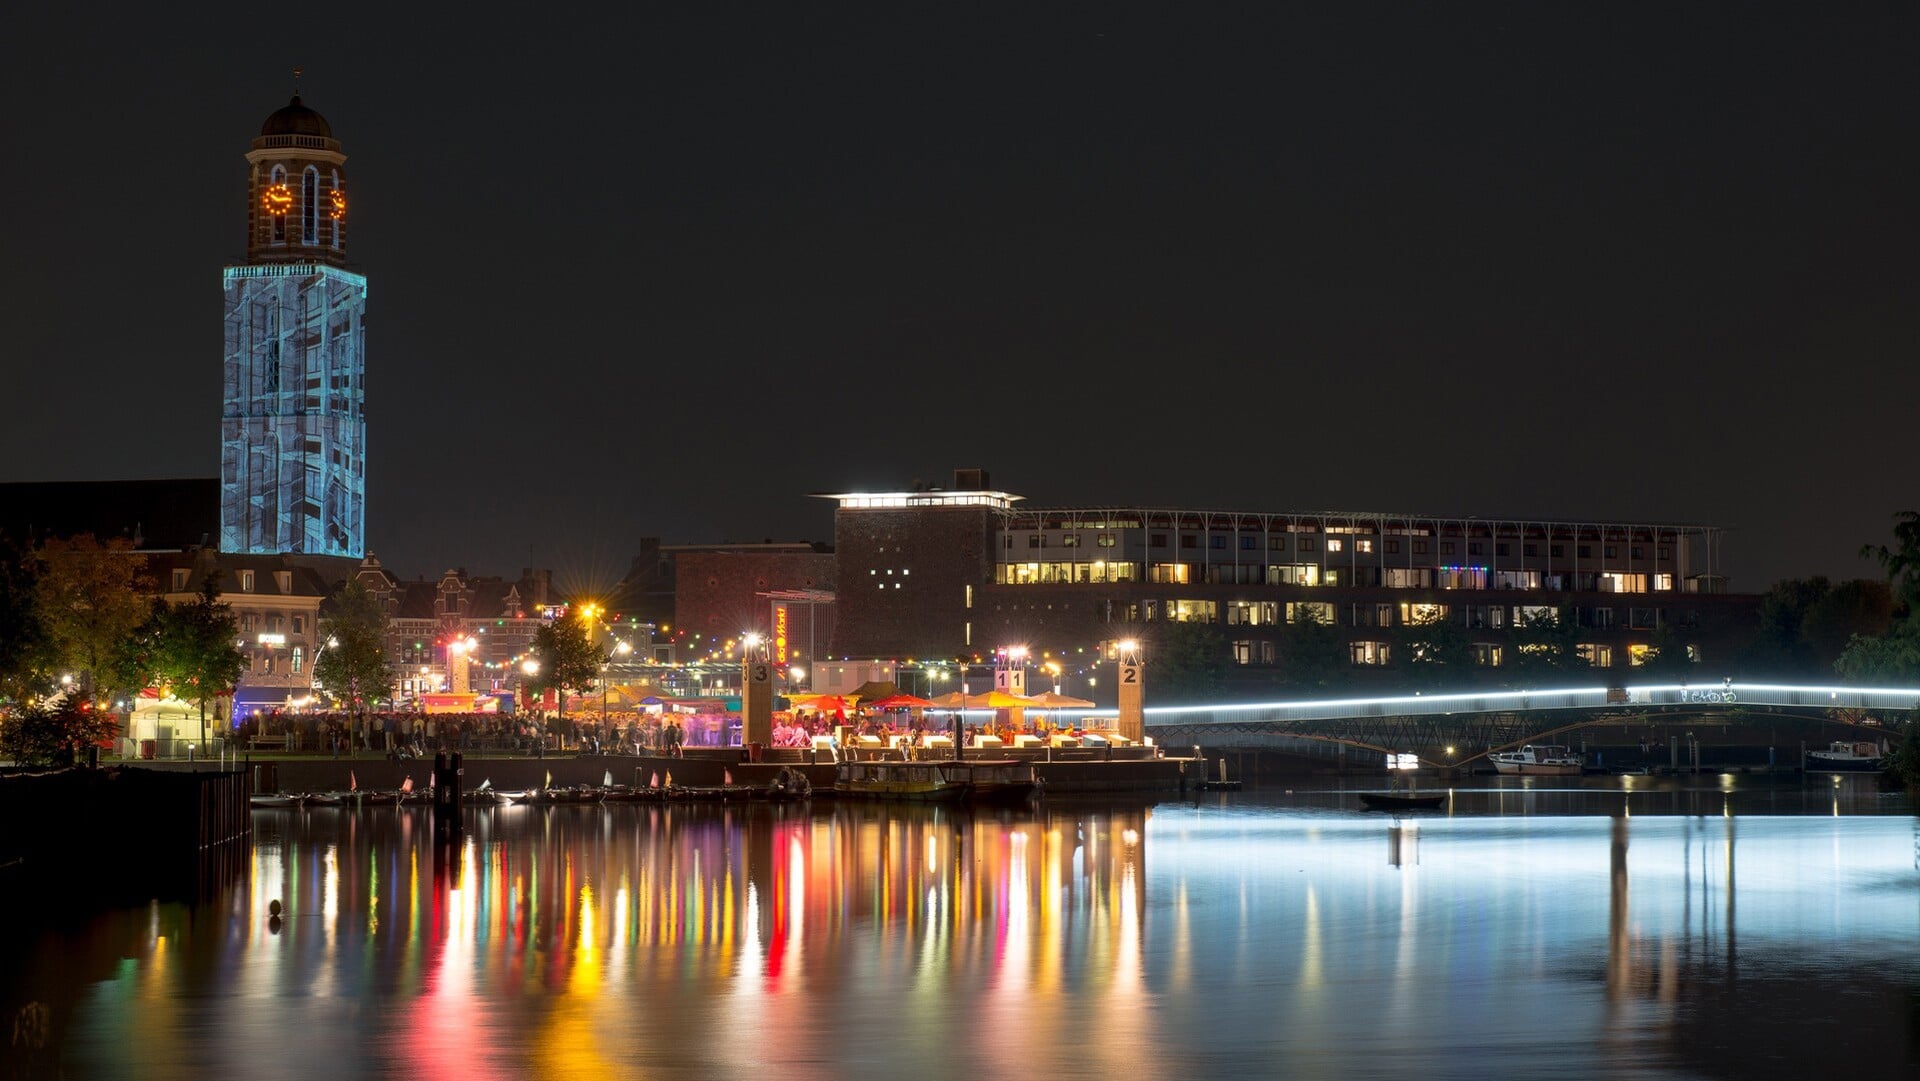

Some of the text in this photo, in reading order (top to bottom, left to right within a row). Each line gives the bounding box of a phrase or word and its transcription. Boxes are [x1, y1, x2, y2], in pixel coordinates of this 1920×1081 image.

[777, 607, 786, 638] Markt
[755, 665, 767, 681] 3
[998, 673, 1005, 686] 1
[1014, 673, 1020, 686] 1
[1124, 668, 1136, 683] 2
